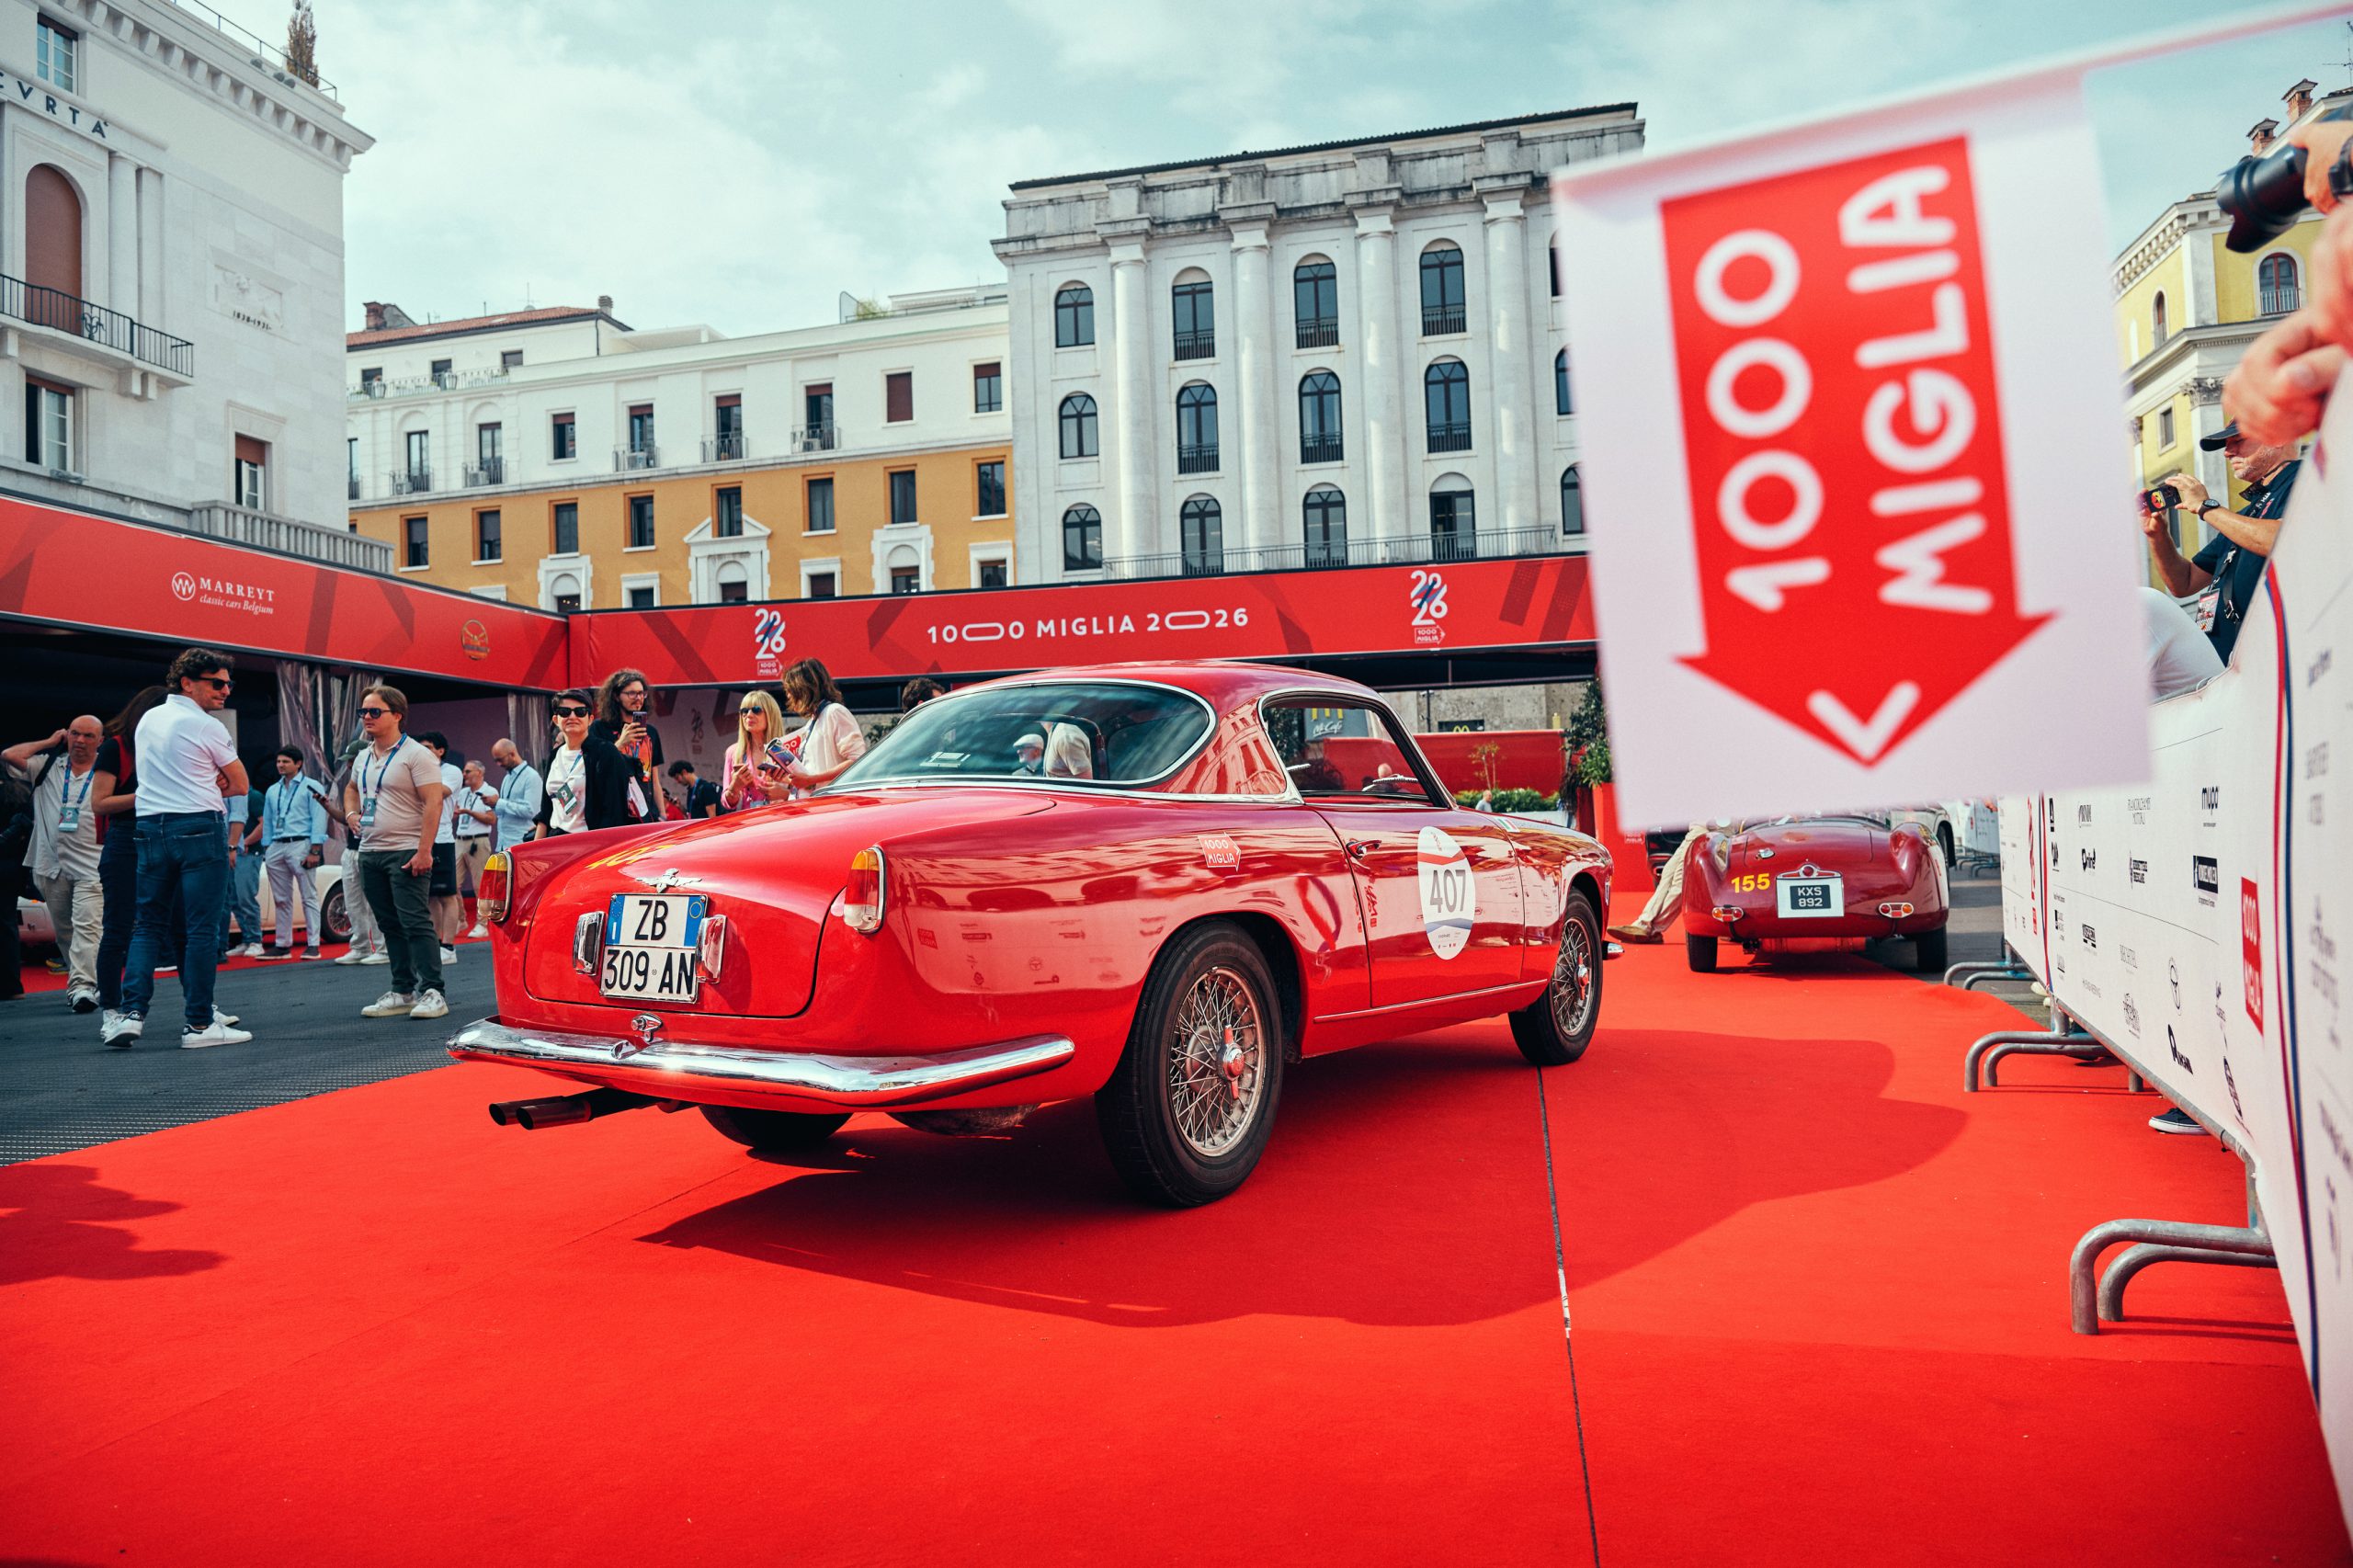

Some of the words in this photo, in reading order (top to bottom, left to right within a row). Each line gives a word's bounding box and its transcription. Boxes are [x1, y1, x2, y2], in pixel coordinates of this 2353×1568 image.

[1839, 165, 1995, 615] MIGLIA
[1695, 228, 1831, 613] 1000
[199, 576, 274, 601] MARREYT
[199, 594, 223, 607] classic
[226, 600, 241, 609] cars
[243, 599, 274, 615] Belgium
[926, 620, 1025, 643] 1000
[1037, 614, 1135, 639] MIGLIA
[1146, 607, 1249, 632] 2026
[1204, 839, 1229, 849] 1000
[1208, 853, 1235, 864] MIGLIA
[1429, 869, 1466, 914] 407
[1731, 872, 1770, 893] 155
[1797, 887, 1823, 897] KXS
[1798, 897, 1823, 907] 892
[634, 899, 669, 941] ZB
[604, 949, 650, 992] 309
[657, 951, 696, 995] AN
